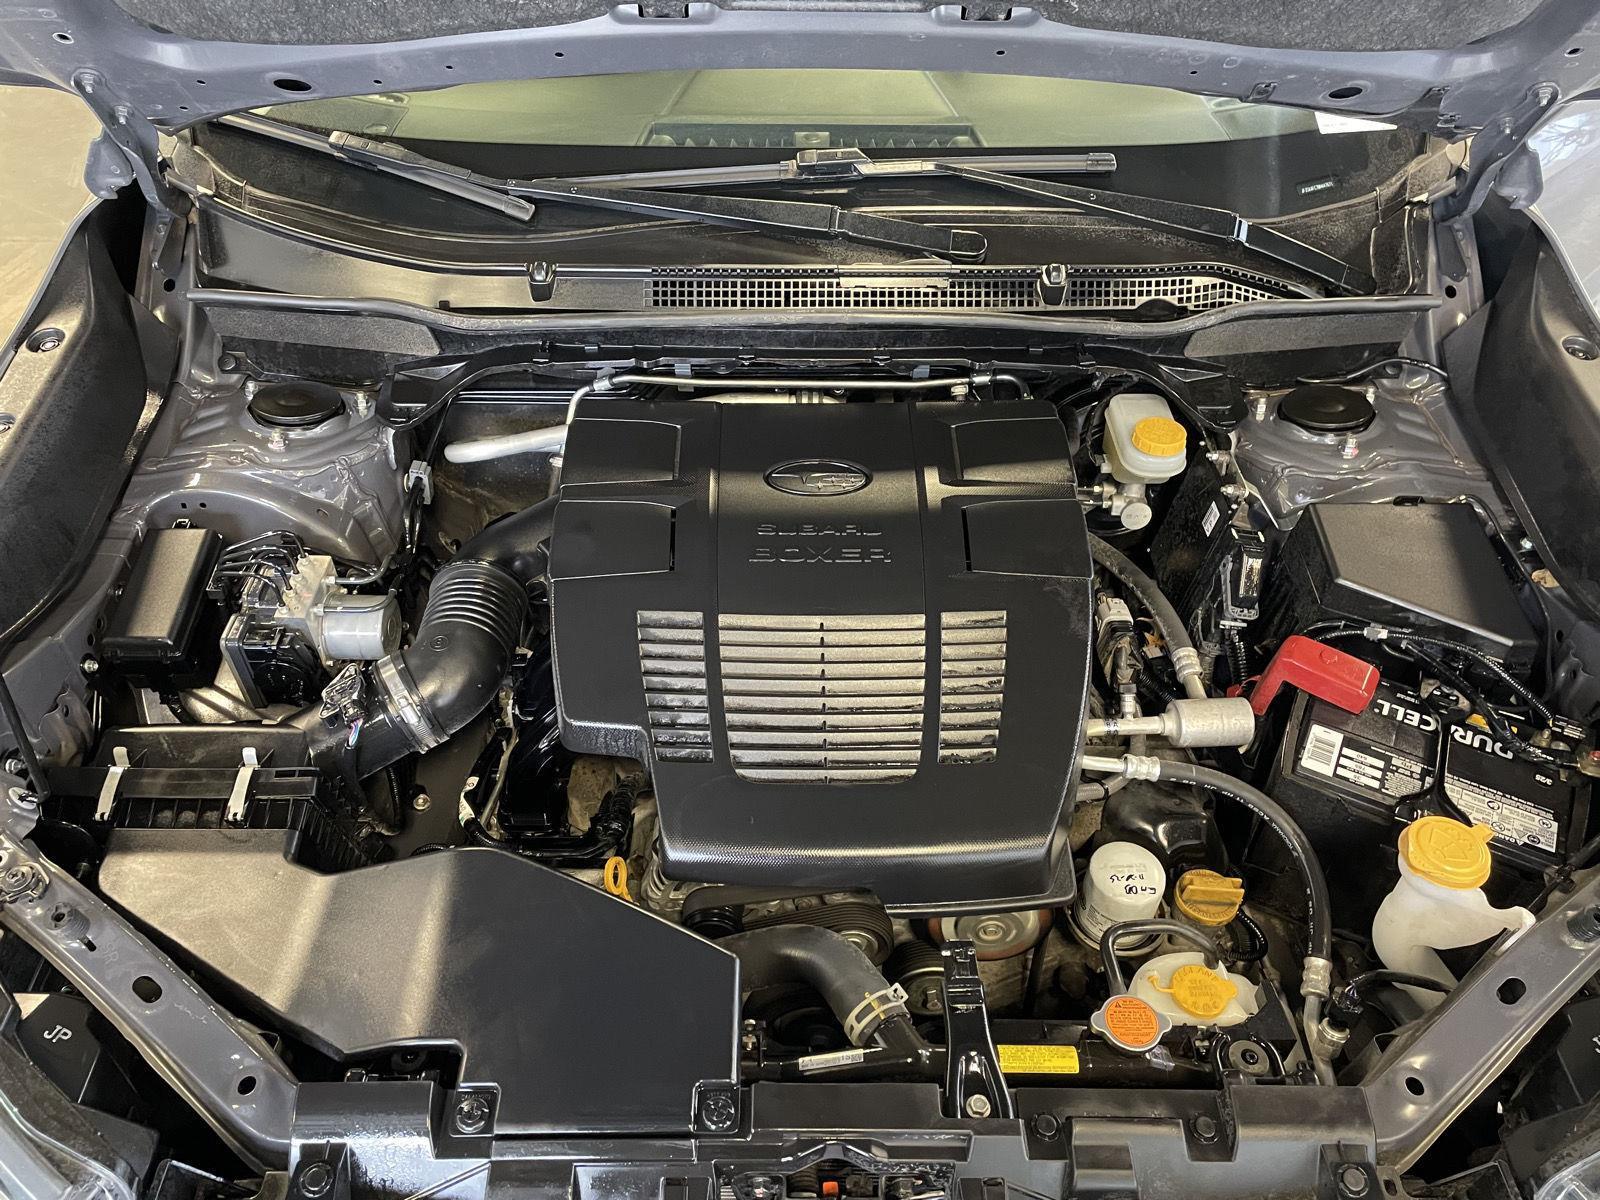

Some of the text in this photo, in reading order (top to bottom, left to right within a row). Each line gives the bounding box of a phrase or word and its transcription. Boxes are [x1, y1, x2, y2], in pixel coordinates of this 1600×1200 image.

[757, 523, 882, 536] SUBARU
[748, 547, 892, 563] BOXER
[43, 1024, 73, 1043] JP
